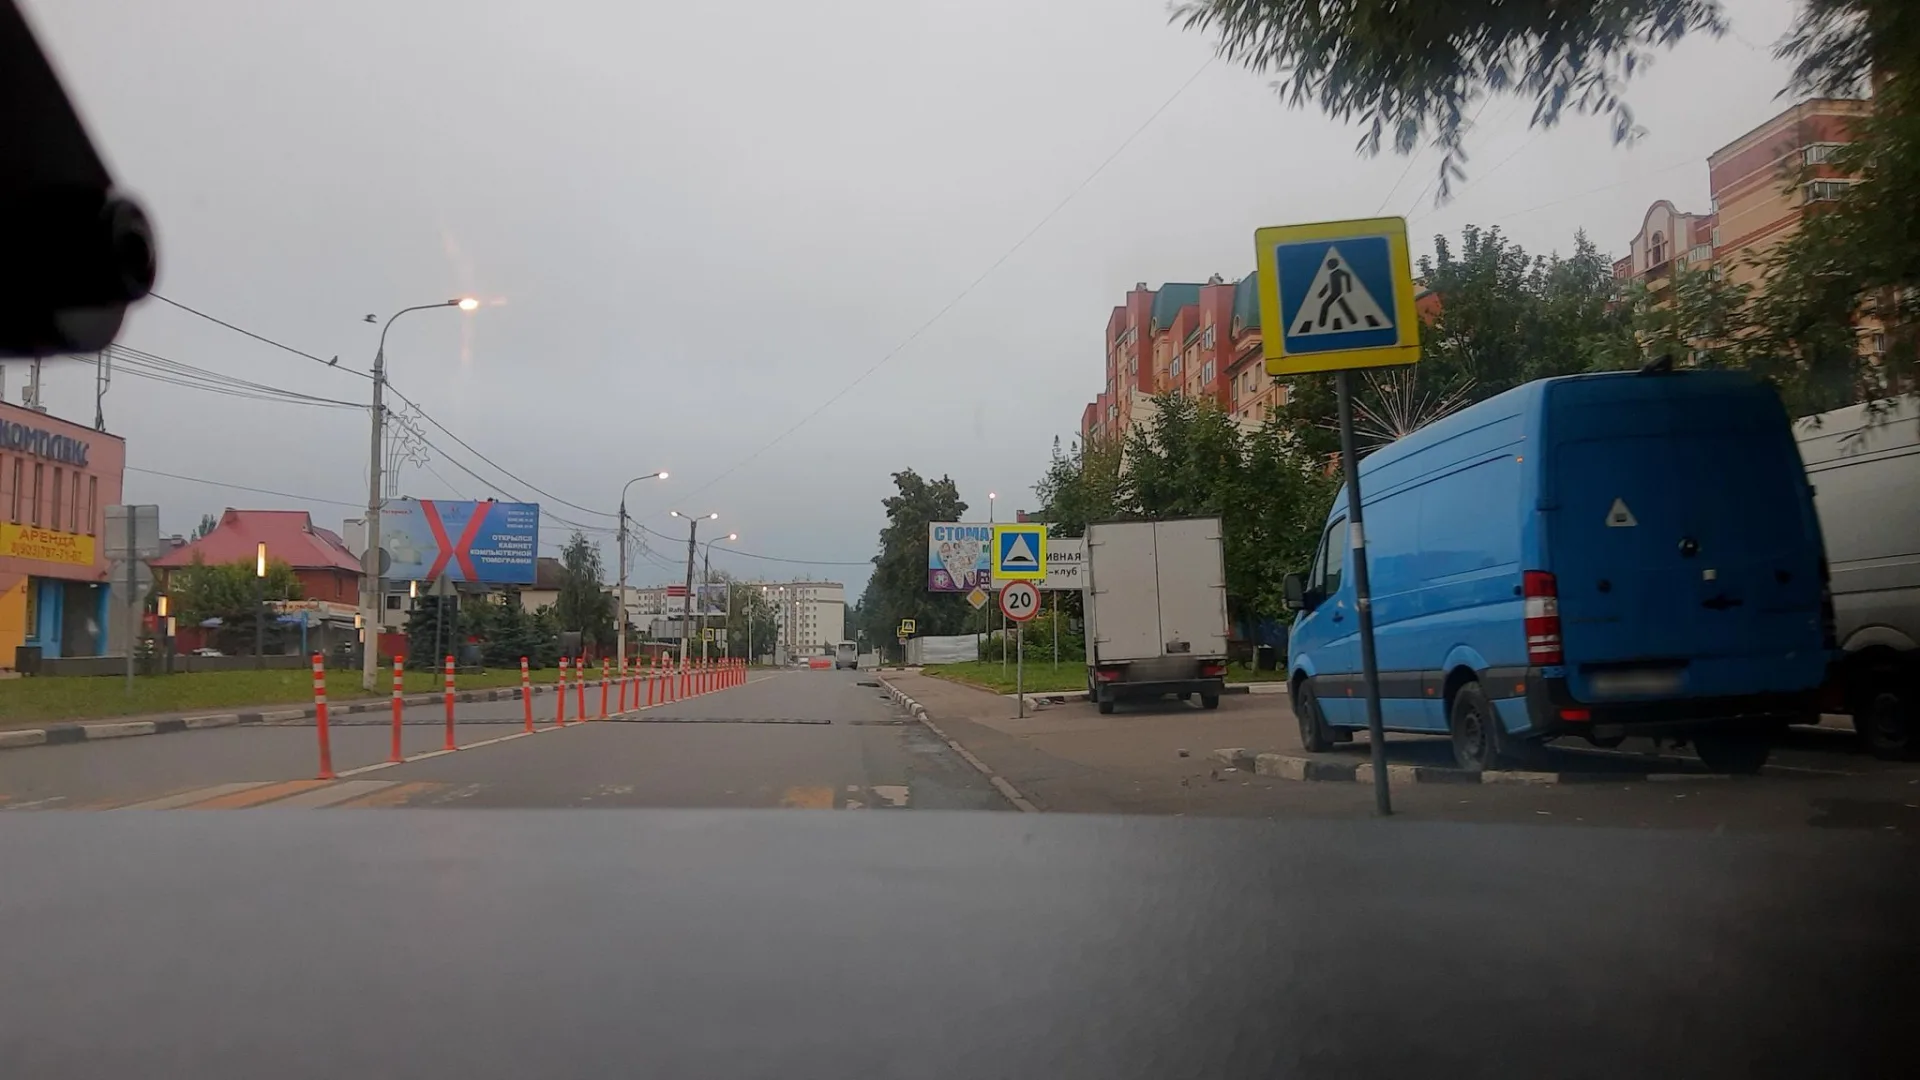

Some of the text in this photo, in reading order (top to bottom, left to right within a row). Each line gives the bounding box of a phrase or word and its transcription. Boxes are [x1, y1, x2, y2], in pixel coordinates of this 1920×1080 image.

[0, 419, 89, 467] КОМПЛЕКС
[19, 528, 76, 547] АРЕНДА
[492, 534, 533, 542] ОТКРЫЛСЯ
[470, 549, 533, 557] КОМПЬЮТЕРНОЙ
[481, 556, 532, 564] ТОМОГРАФИИ
[1046, 566, 1077, 578] -клуб
[1009, 592, 1031, 609] 20
